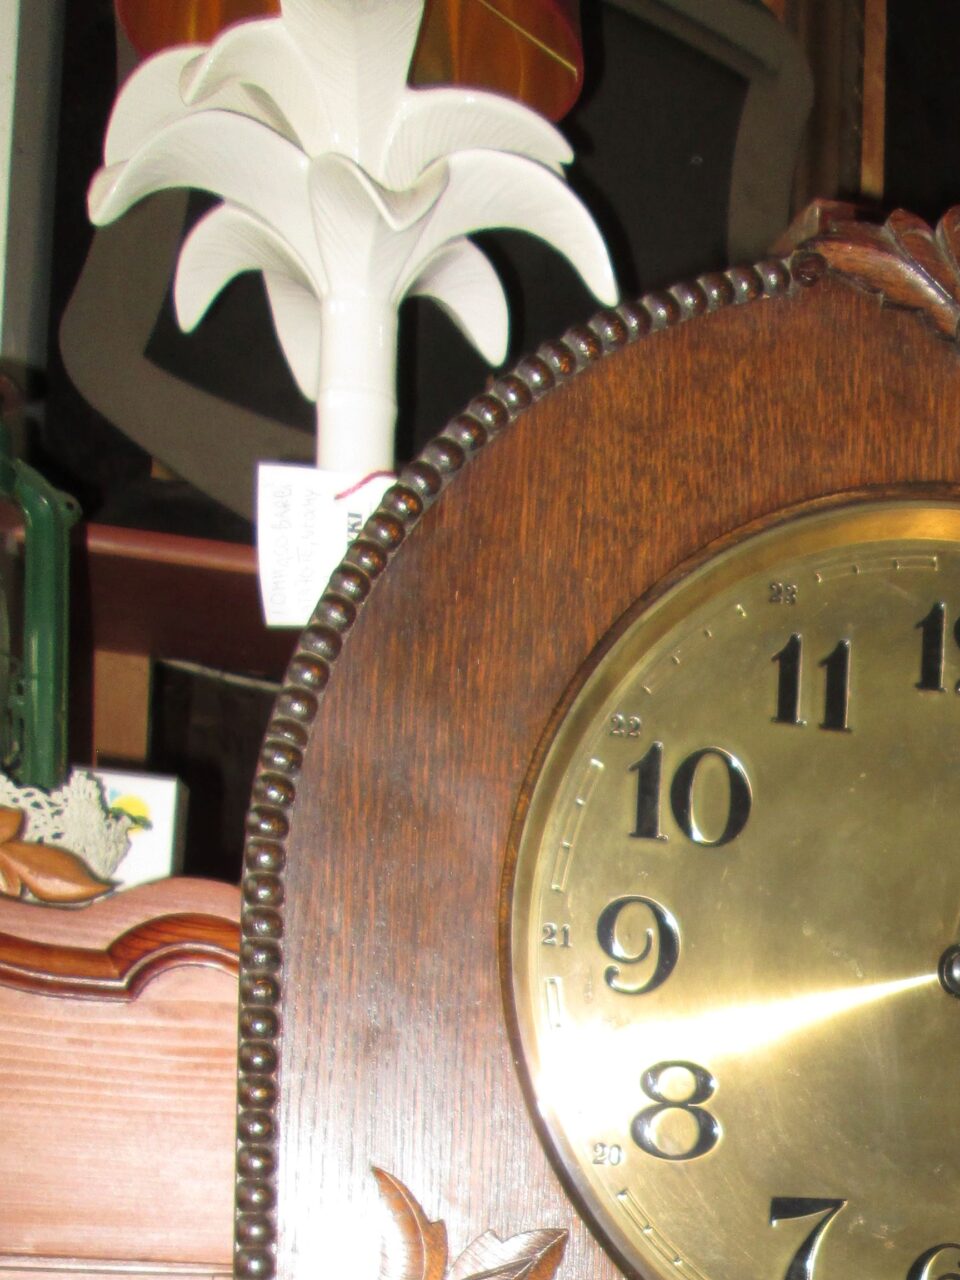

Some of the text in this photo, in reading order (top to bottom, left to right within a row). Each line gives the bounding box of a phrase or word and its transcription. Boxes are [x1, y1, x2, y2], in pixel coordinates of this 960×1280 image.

[769, 582, 798, 604] 23
[771, 631, 852, 733] 11
[610, 714, 642, 738] 22
[629, 740, 753, 847] 10
[541, 922, 572, 948] 21
[597, 895, 681, 994] 9
[631, 1060, 723, 1161] 8
[591, 1142, 622, 1166] 20
